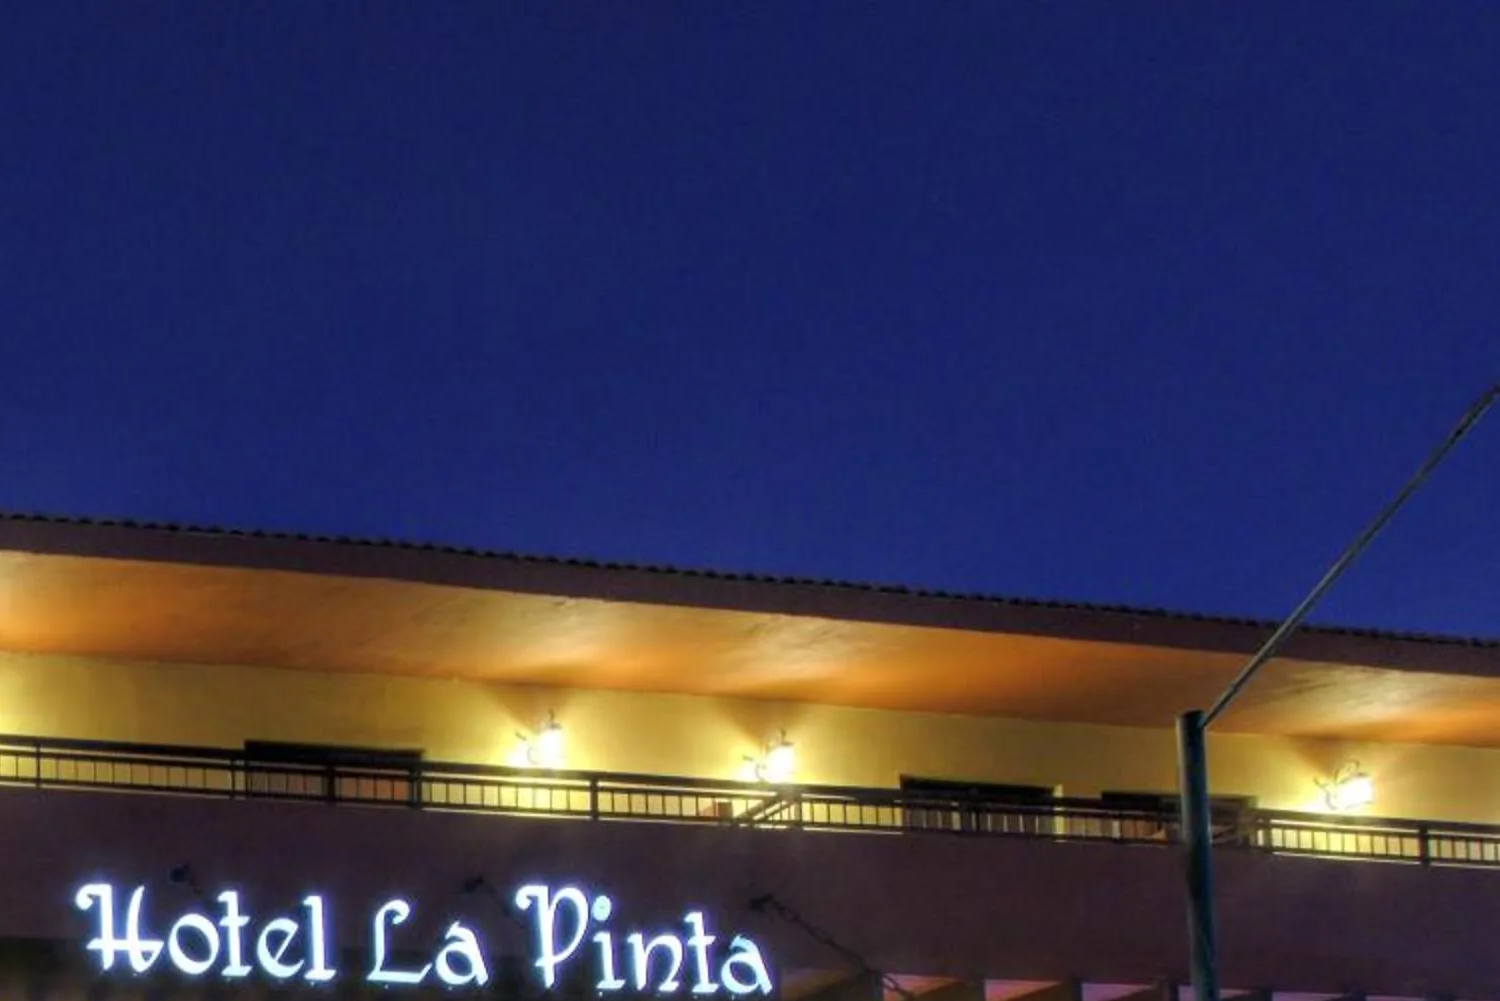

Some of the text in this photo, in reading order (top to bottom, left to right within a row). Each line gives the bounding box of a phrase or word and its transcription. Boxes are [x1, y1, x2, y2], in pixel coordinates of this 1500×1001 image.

[76, 882, 774, 996] Hotel La Pinta
